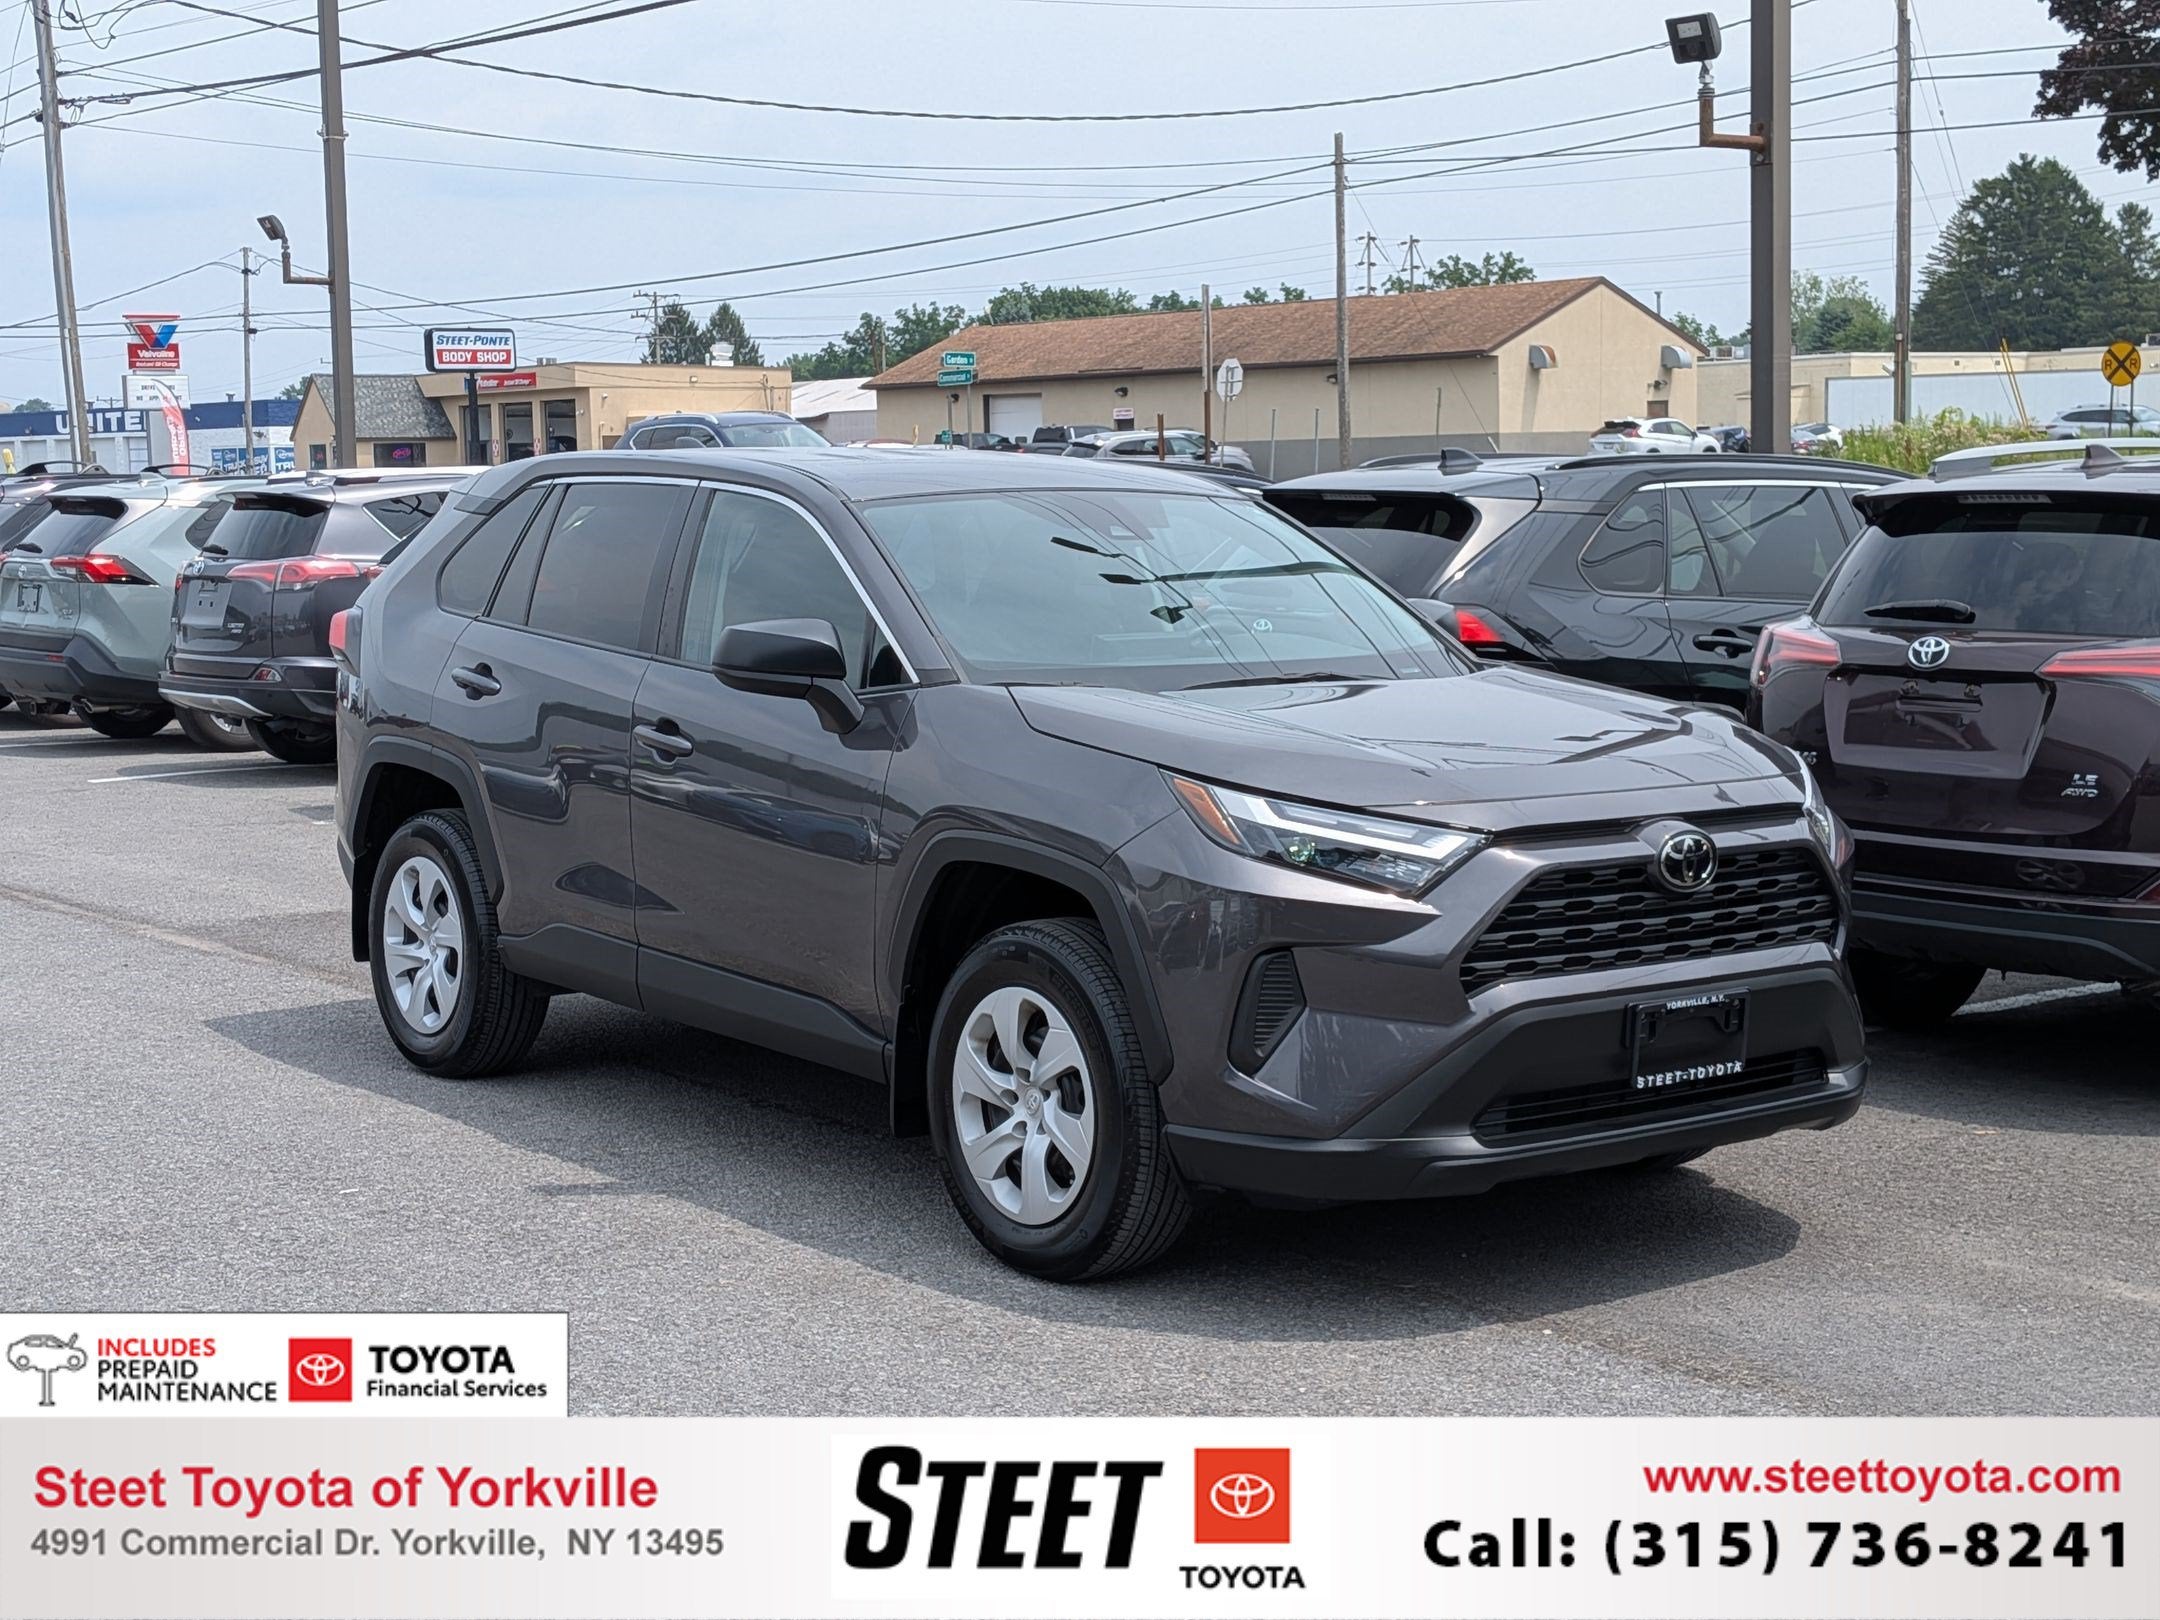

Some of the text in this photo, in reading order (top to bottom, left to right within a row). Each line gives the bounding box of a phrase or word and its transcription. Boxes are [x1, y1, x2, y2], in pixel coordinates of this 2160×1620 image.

[436, 334, 511, 346] STEET-PONTE
[137, 350, 175, 358] Valvoline
[442, 351, 507, 362] BODY SHOP
[2105, 358, 2137, 370] R R
[56, 410, 147, 434] UITE
[2072, 773, 2098, 786] LE
[1666, 996, 1710, 1010] YORKVILLE,
[1636, 1060, 1743, 1089] STEET-TOYOTA
